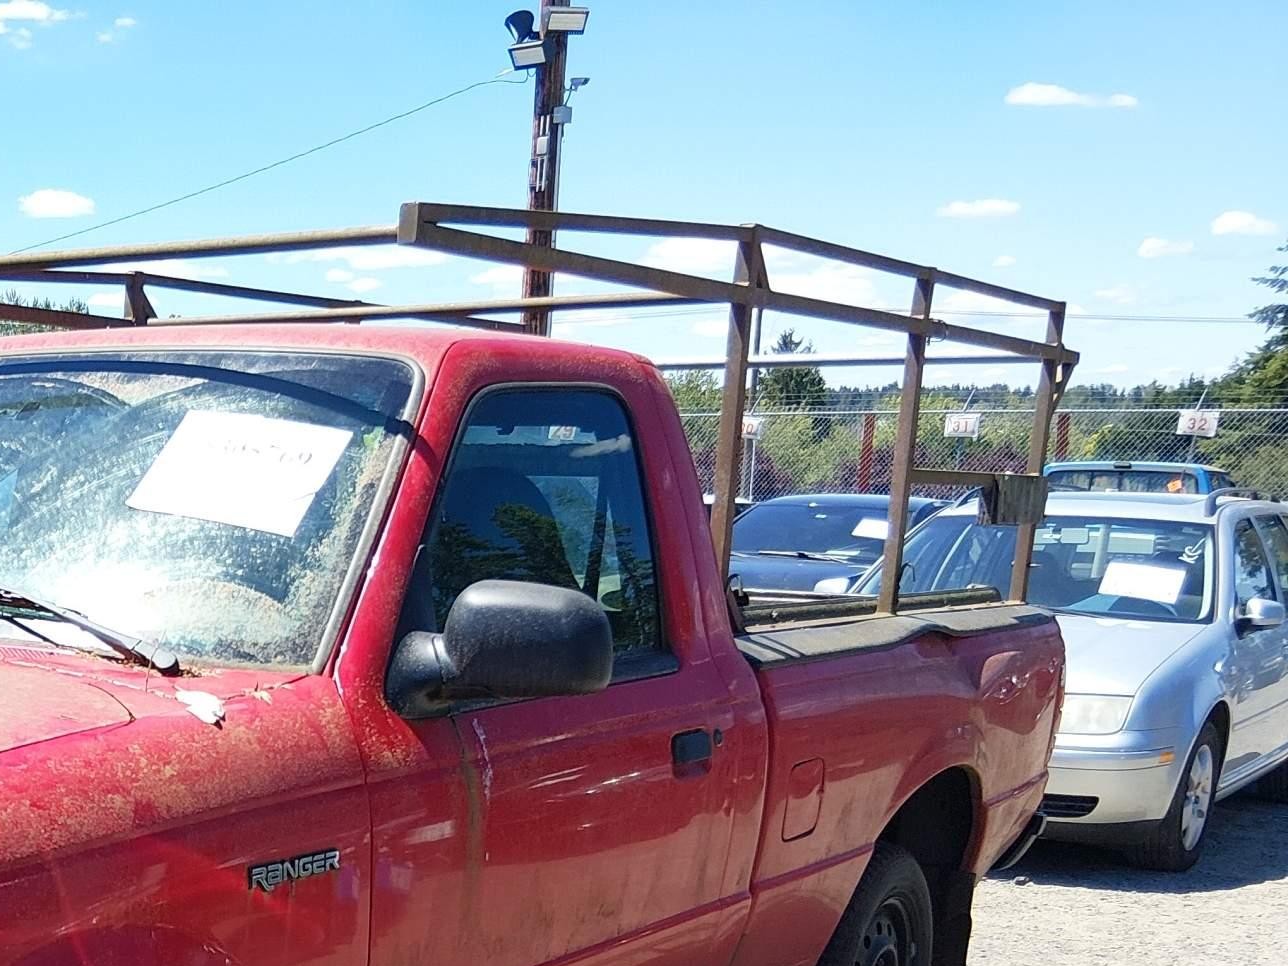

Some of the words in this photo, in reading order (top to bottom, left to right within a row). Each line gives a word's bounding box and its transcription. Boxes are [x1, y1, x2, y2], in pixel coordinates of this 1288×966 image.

[952, 420, 968, 433] 31
[1187, 417, 1208, 431] 32
[250, 850, 340, 891] RANGER
